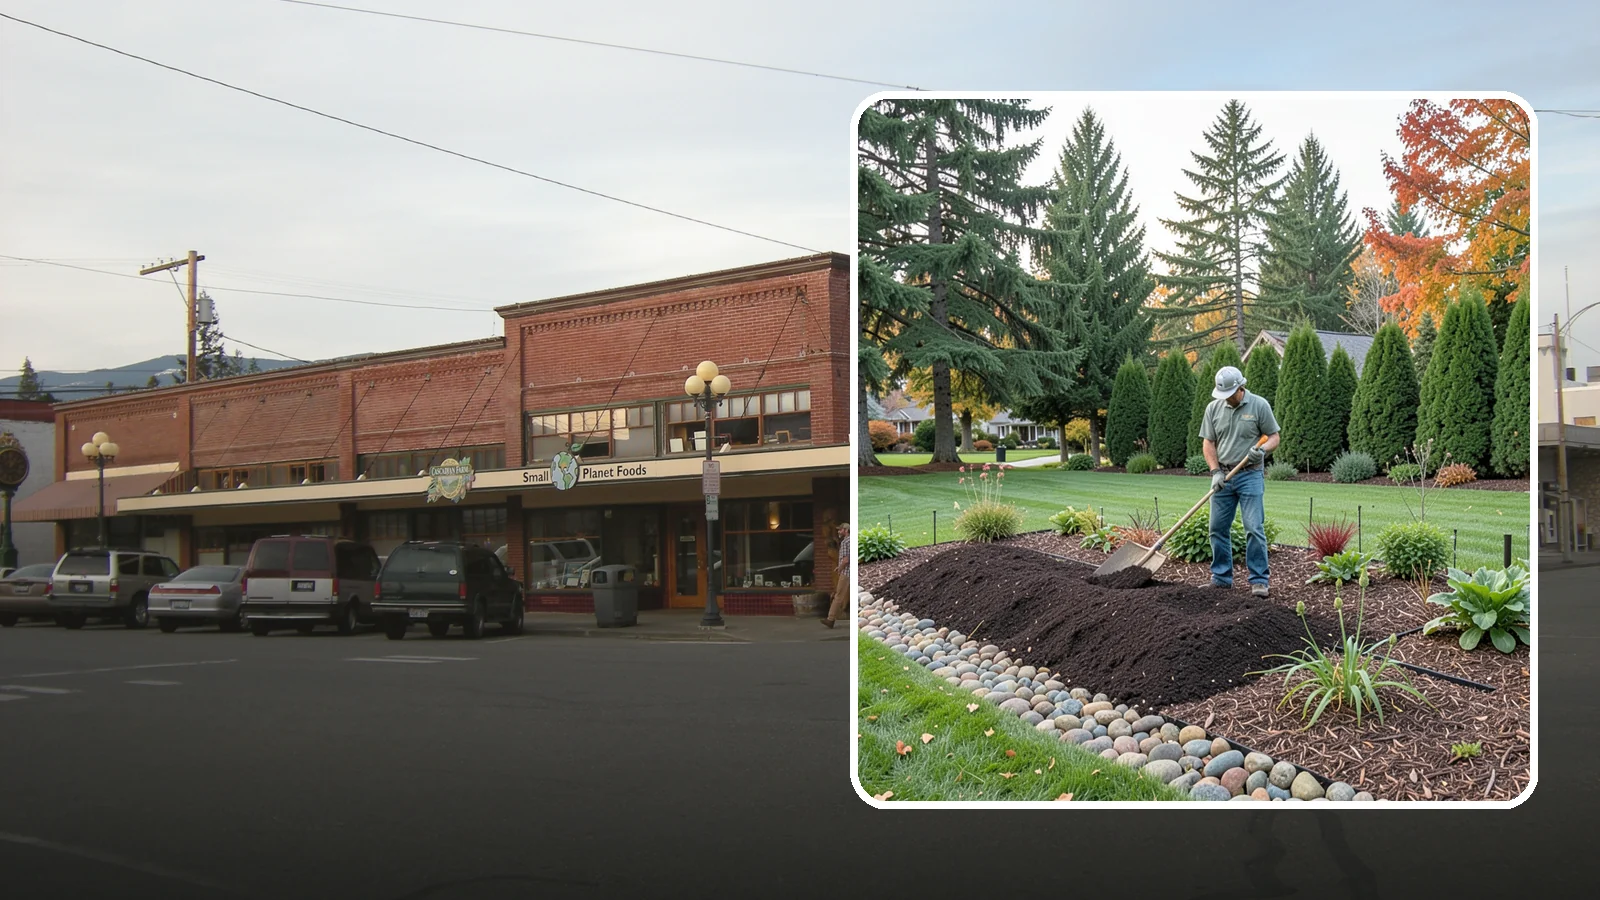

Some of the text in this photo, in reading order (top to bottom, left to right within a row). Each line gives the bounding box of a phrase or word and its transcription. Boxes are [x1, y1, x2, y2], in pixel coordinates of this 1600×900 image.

[523, 464, 647, 482] Small Planet Foods
